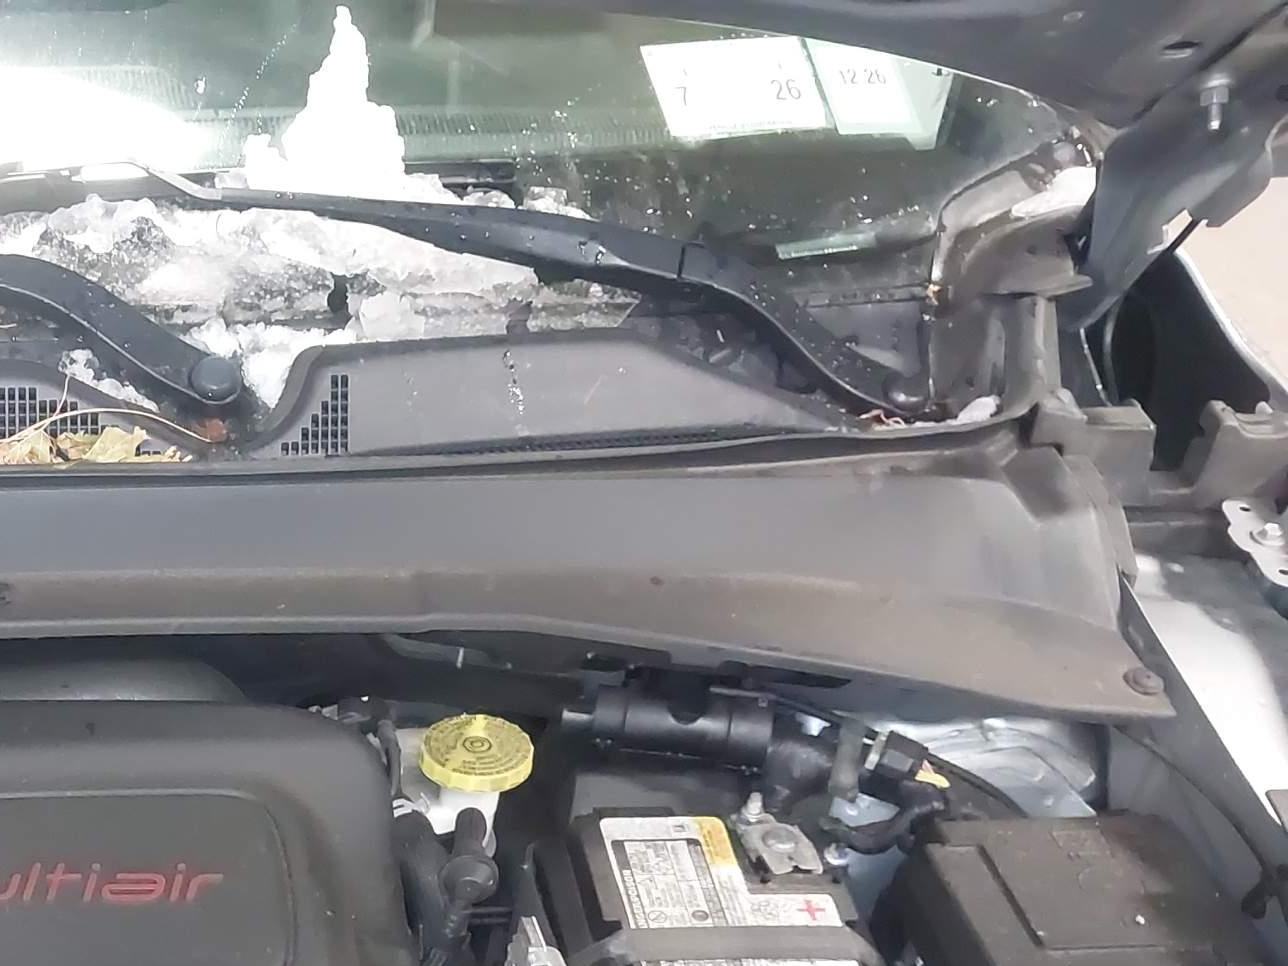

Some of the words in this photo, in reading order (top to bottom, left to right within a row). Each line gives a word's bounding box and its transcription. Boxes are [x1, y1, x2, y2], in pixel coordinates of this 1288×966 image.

[863, 68, 887, 84] 26
[675, 86, 688, 106] 7
[770, 79, 801, 100] 26
